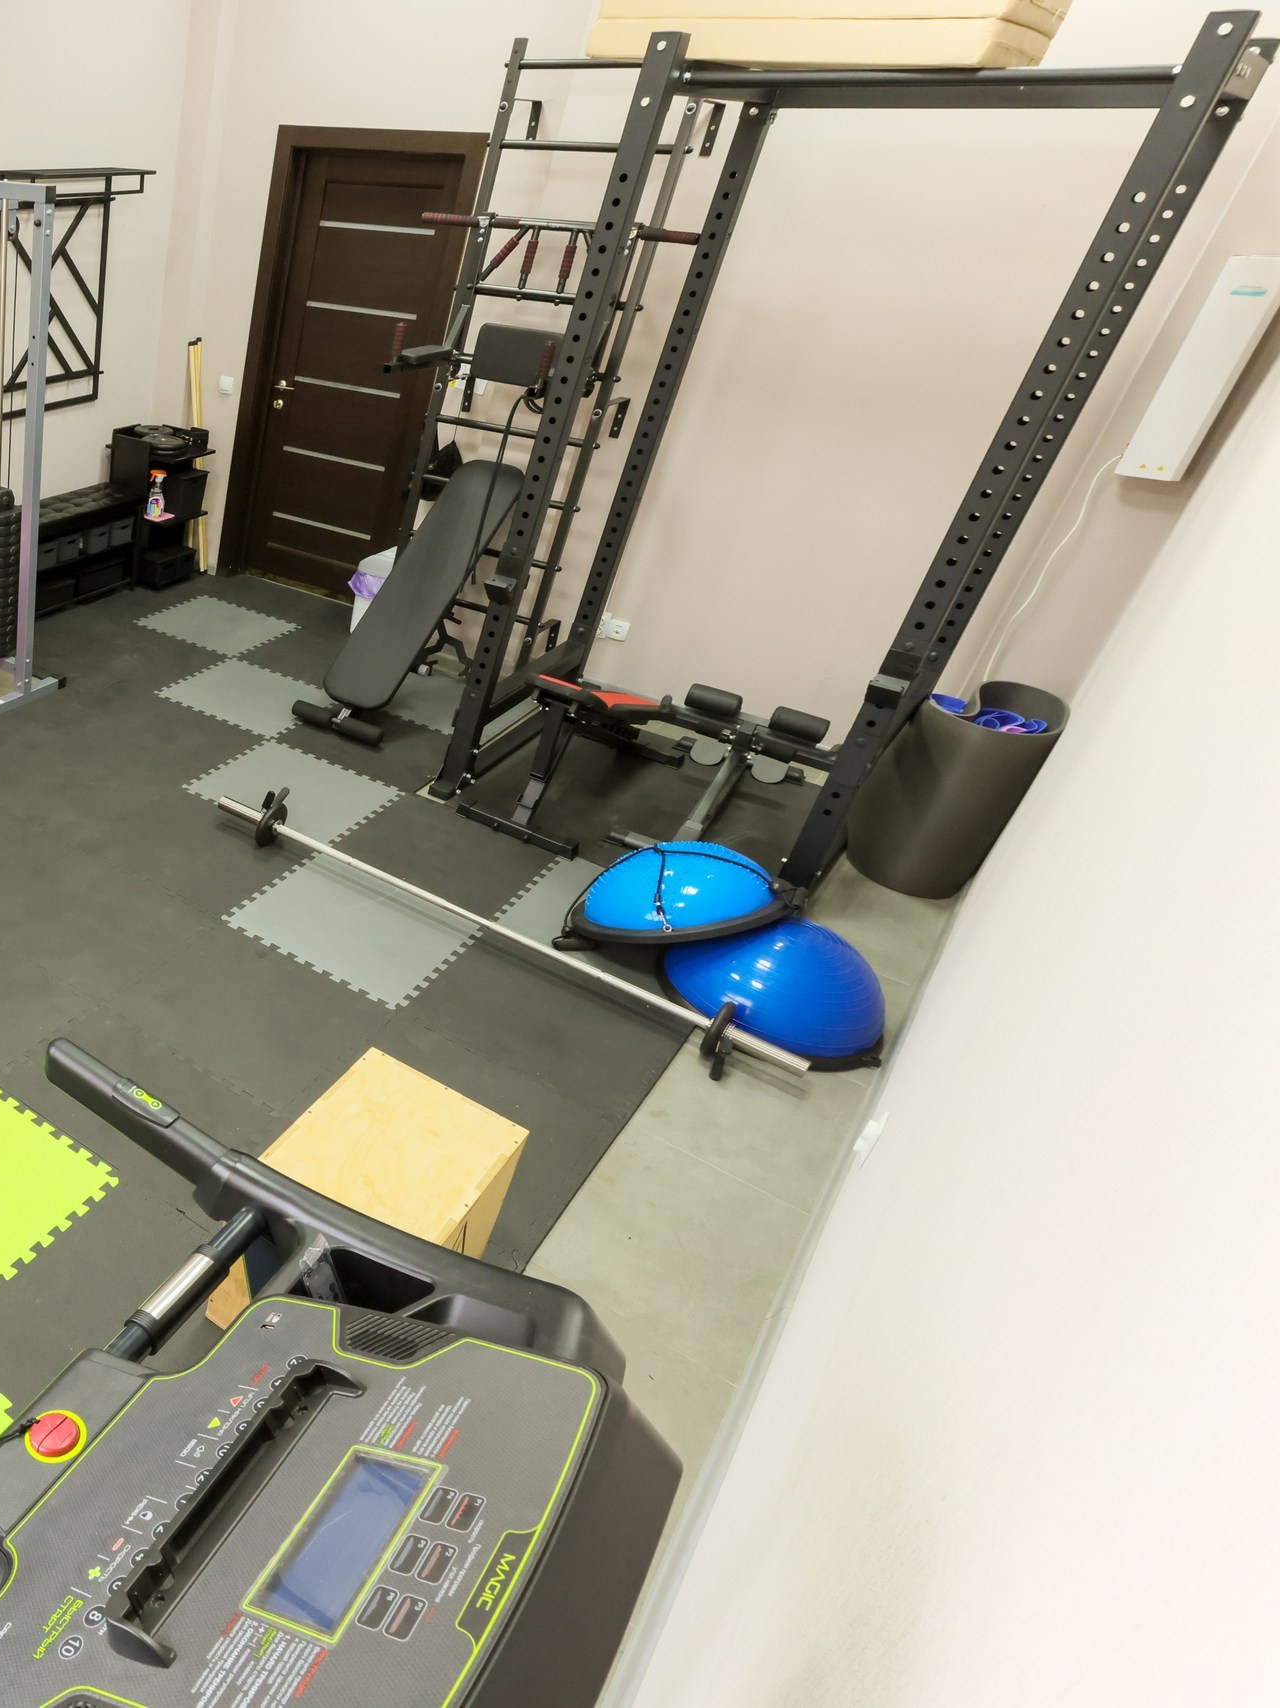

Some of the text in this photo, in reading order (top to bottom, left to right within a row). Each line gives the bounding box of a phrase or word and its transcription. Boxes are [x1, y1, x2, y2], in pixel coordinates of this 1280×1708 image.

[472, 1497, 482, 1507] P1
[444, 1547, 453, 1557] P2
[475, 1552, 516, 1611] MAGIC
[41, 1594, 74, 1633] СТАРТ
[87, 1609, 102, 1623] 8
[413, 1601, 423, 1611] P3
[31, 1599, 84, 1659] БЫСТРЫЙ
[60, 1636, 81, 1657] 10
[222, 1627, 254, 1670] ОКОНЧАНИЕ
[264, 1640, 286, 1670] НАЧАЛО
